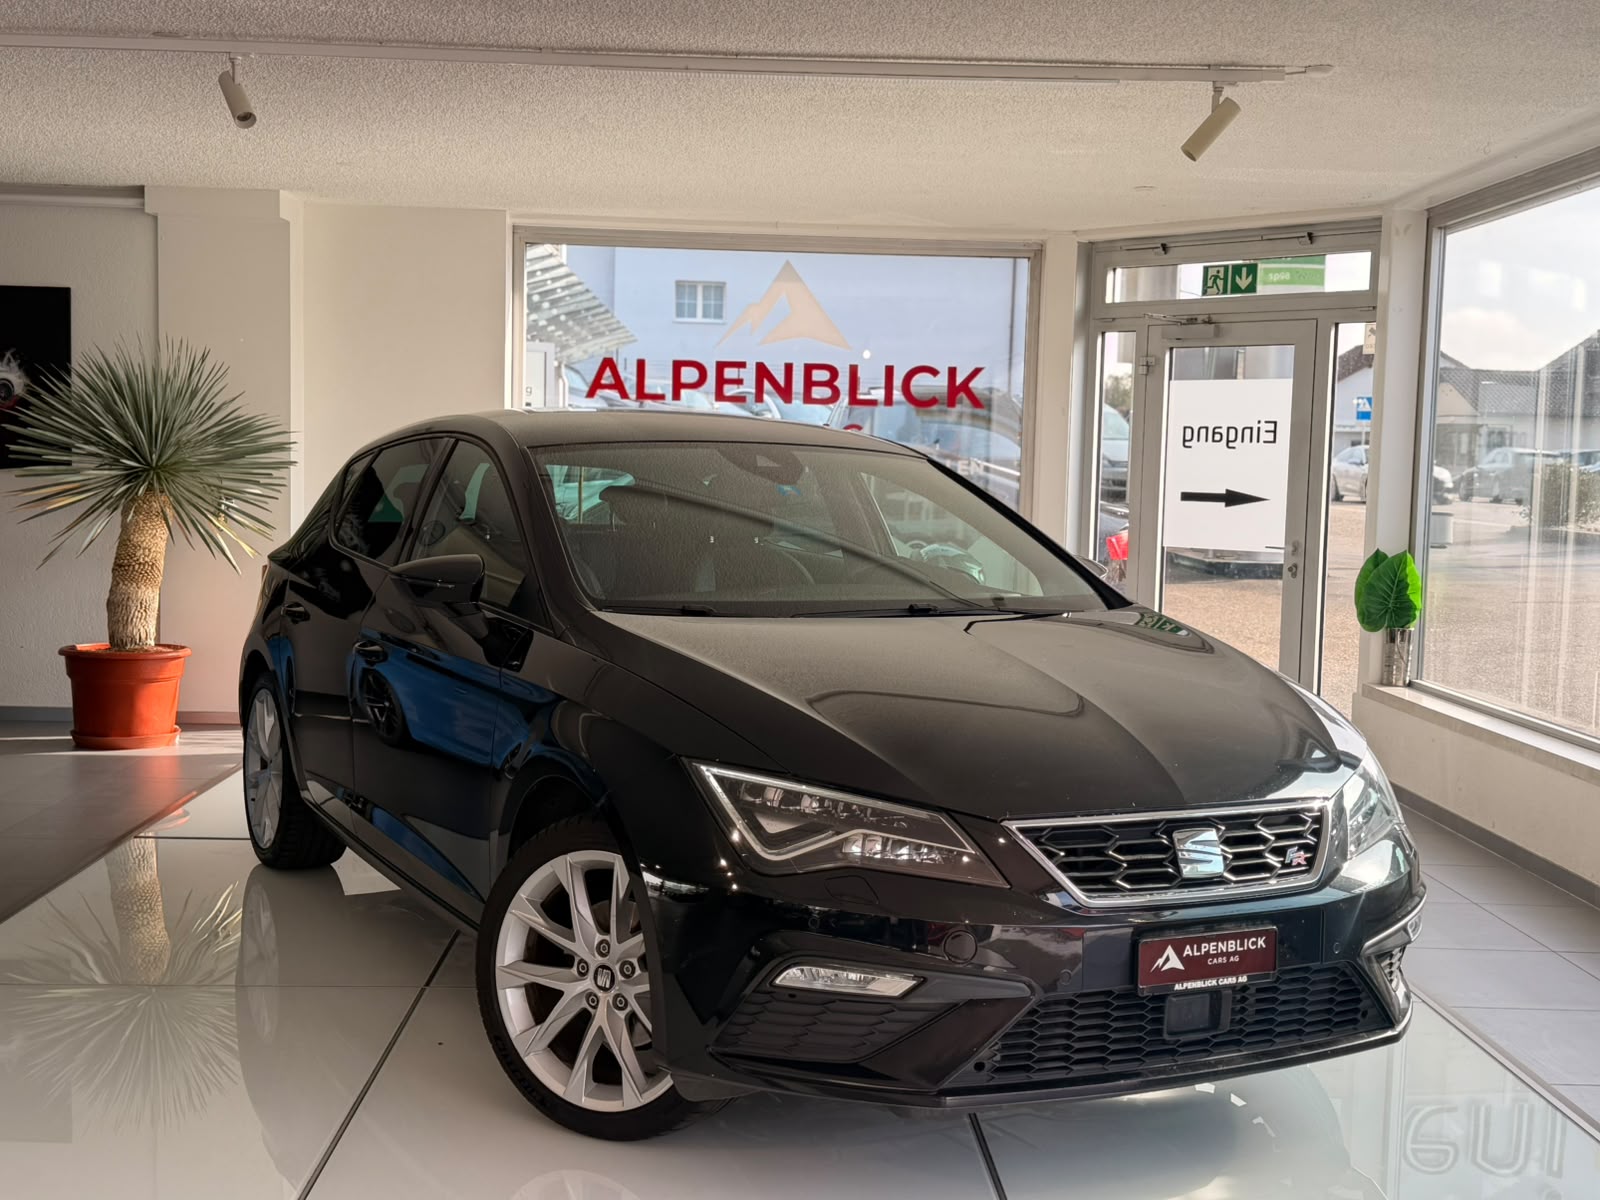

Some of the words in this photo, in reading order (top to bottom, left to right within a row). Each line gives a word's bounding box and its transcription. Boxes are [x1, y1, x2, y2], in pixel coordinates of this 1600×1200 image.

[585, 356, 986, 409] ALPENBLICK
[1182, 936, 1267, 957] ALPENBLICK
[1207, 956, 1227, 965] CARS
[1229, 955, 1240, 963] AG
[1174, 978, 1217, 991] ALPENBLICK
[1218, 976, 1236, 986] CARS
[1237, 975, 1248, 983] AG
